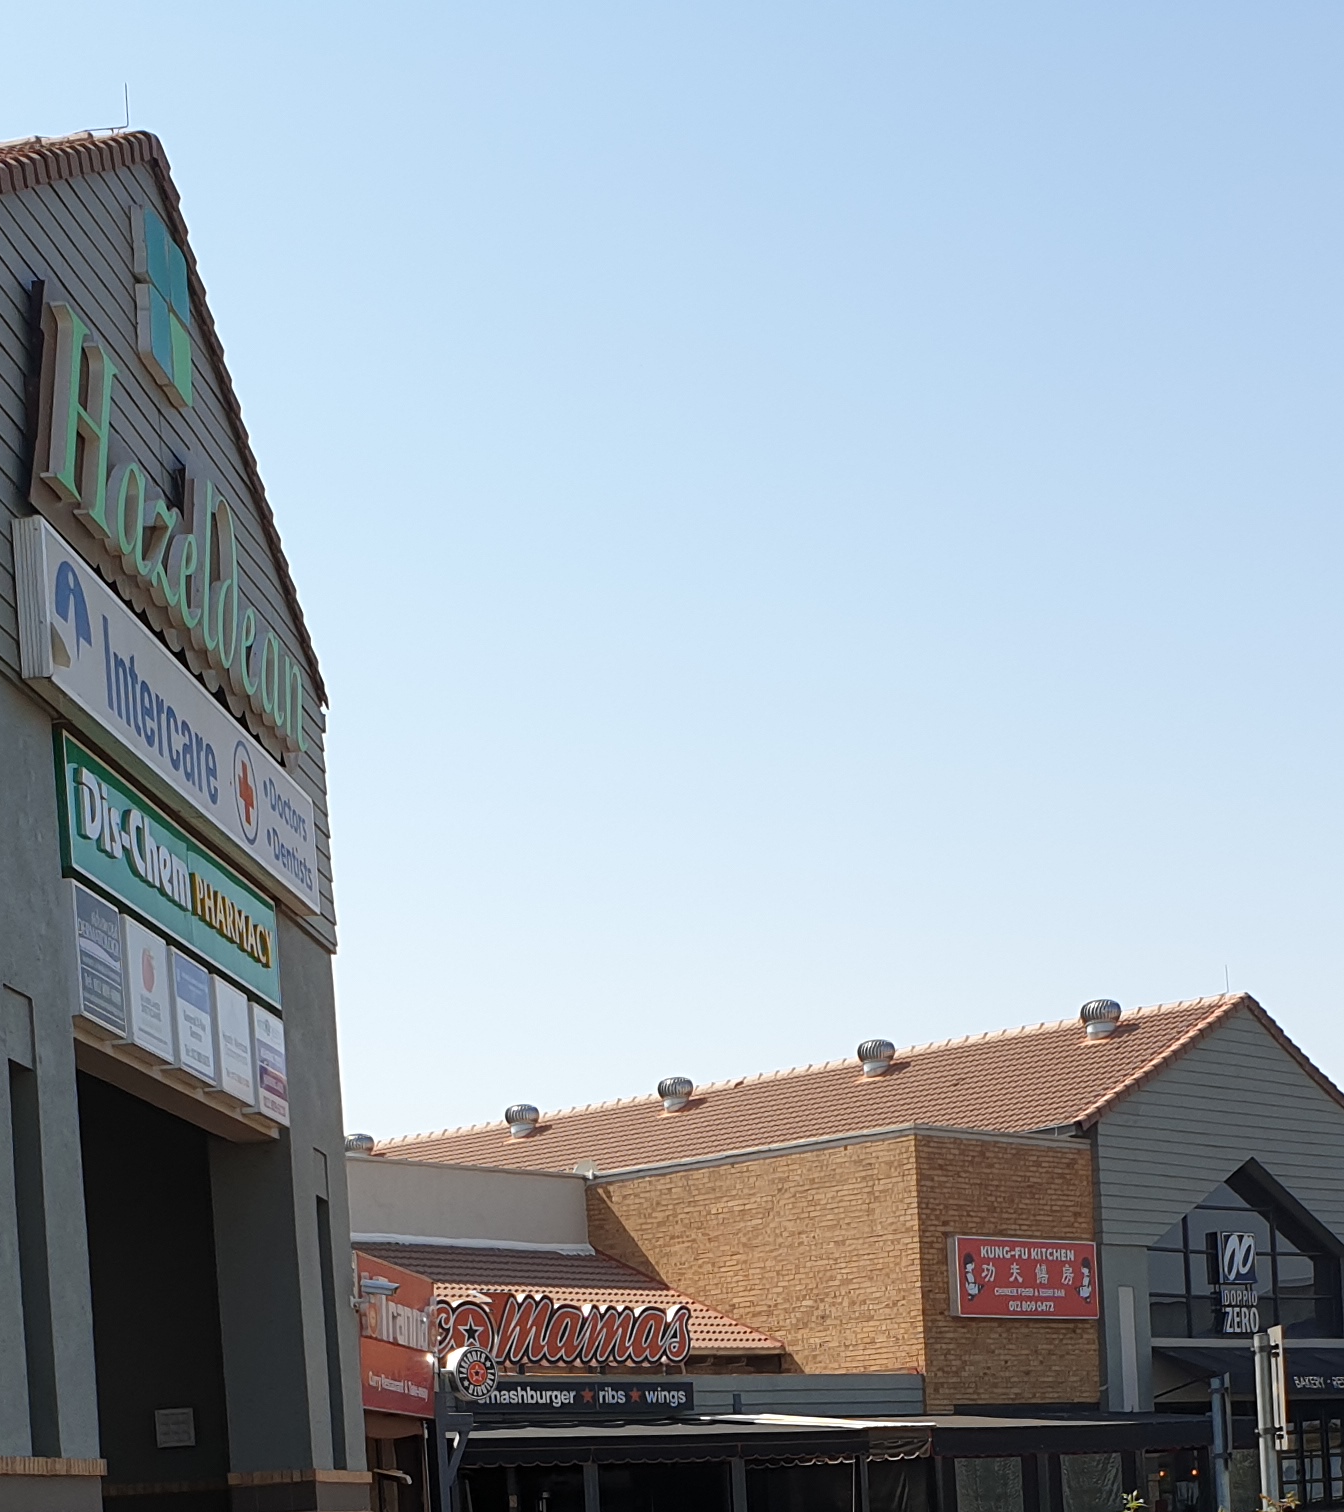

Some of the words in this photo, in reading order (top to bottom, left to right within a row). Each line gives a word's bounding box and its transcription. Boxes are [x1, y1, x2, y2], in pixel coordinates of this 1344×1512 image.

[101, 613, 220, 806] Intercare
[268, 776, 308, 843] Doctors
[79, 766, 192, 912] Dis-Chem
[194, 872, 273, 969] PHARMACY
[272, 826, 314, 892] Dentists
[980, 1246, 1029, 1260] KUNG-FU
[1031, 1247, 1075, 1262] KITCHEN
[1008, 1300, 1022, 1311] 012
[1222, 1290, 1258, 1306] DOPPIO
[1223, 1307, 1260, 1333] ZERO
[1293, 1375, 1326, 1389] BAKERY
[599, 1386, 626, 1405] ribs
[645, 1386, 687, 1408] wings
